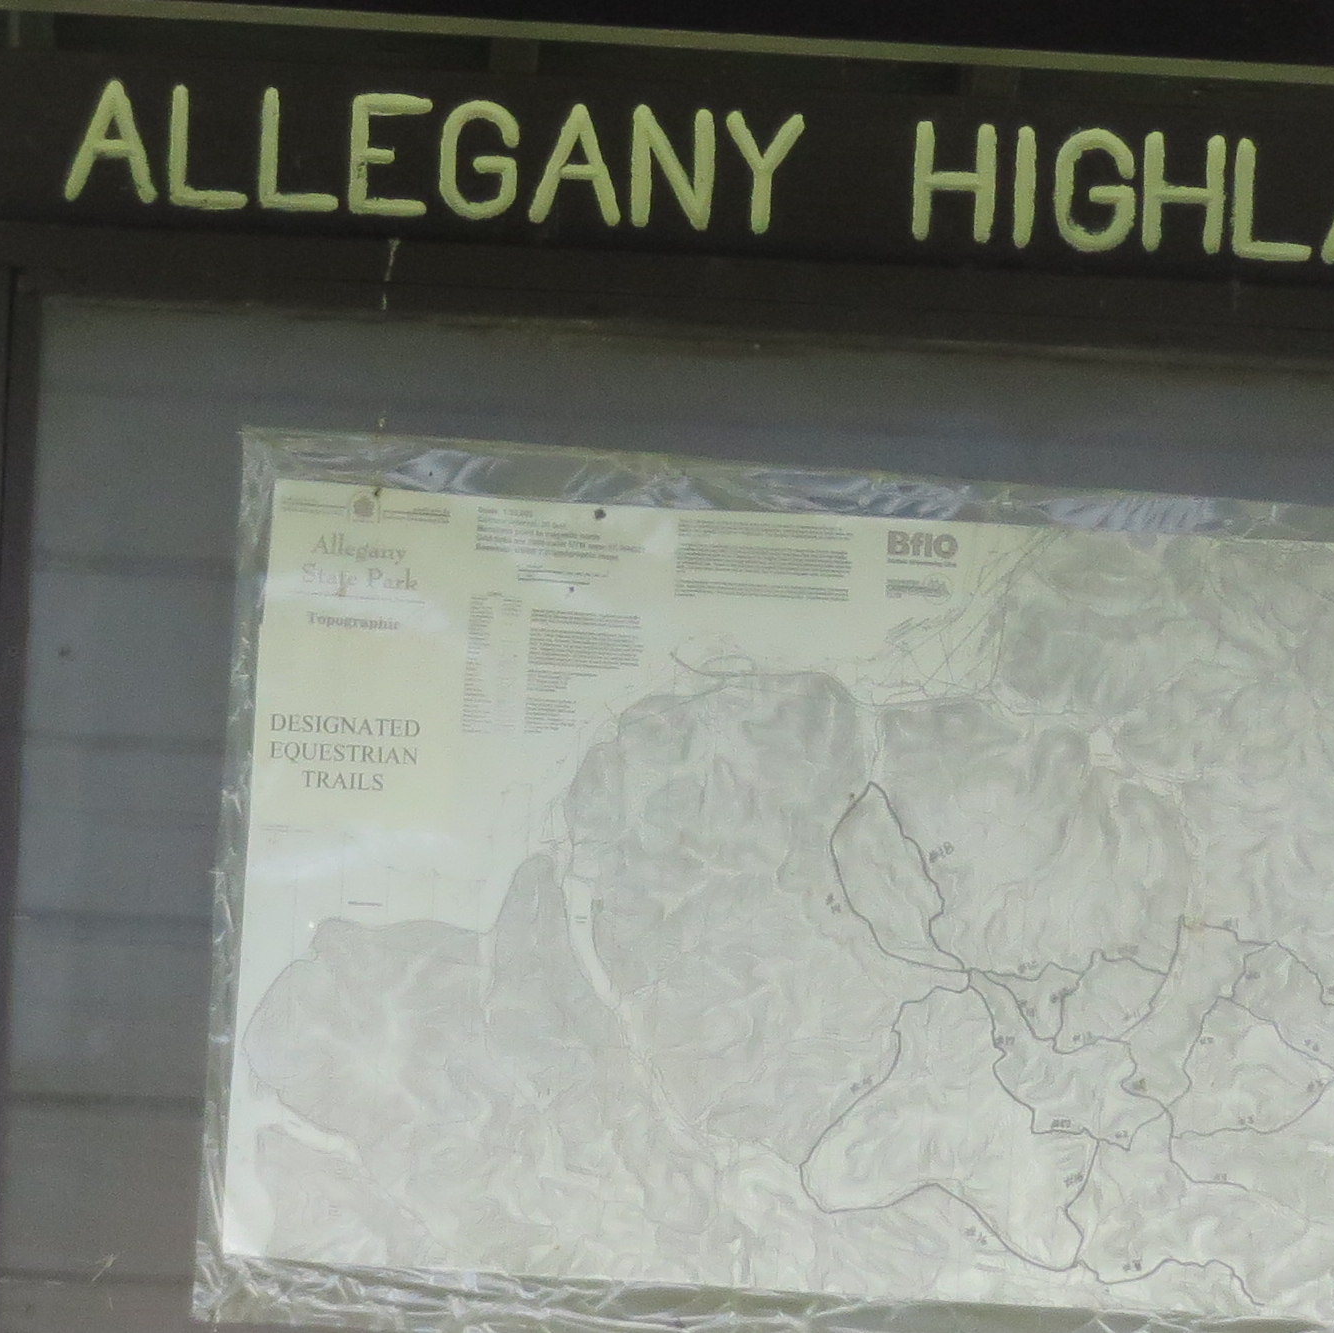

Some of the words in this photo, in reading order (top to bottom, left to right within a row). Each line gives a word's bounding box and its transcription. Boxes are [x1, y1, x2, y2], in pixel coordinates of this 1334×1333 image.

[65, 79, 805, 235] ALLEGANY
[310, 532, 407, 564] Allegany
[368, 567, 418, 591] Park
[306, 611, 401, 630] Topographic
[270, 713, 421, 738] DESIGNATED
[269, 740, 418, 765] EQUESTRIAN
[302, 770, 384, 791] TRAILS
